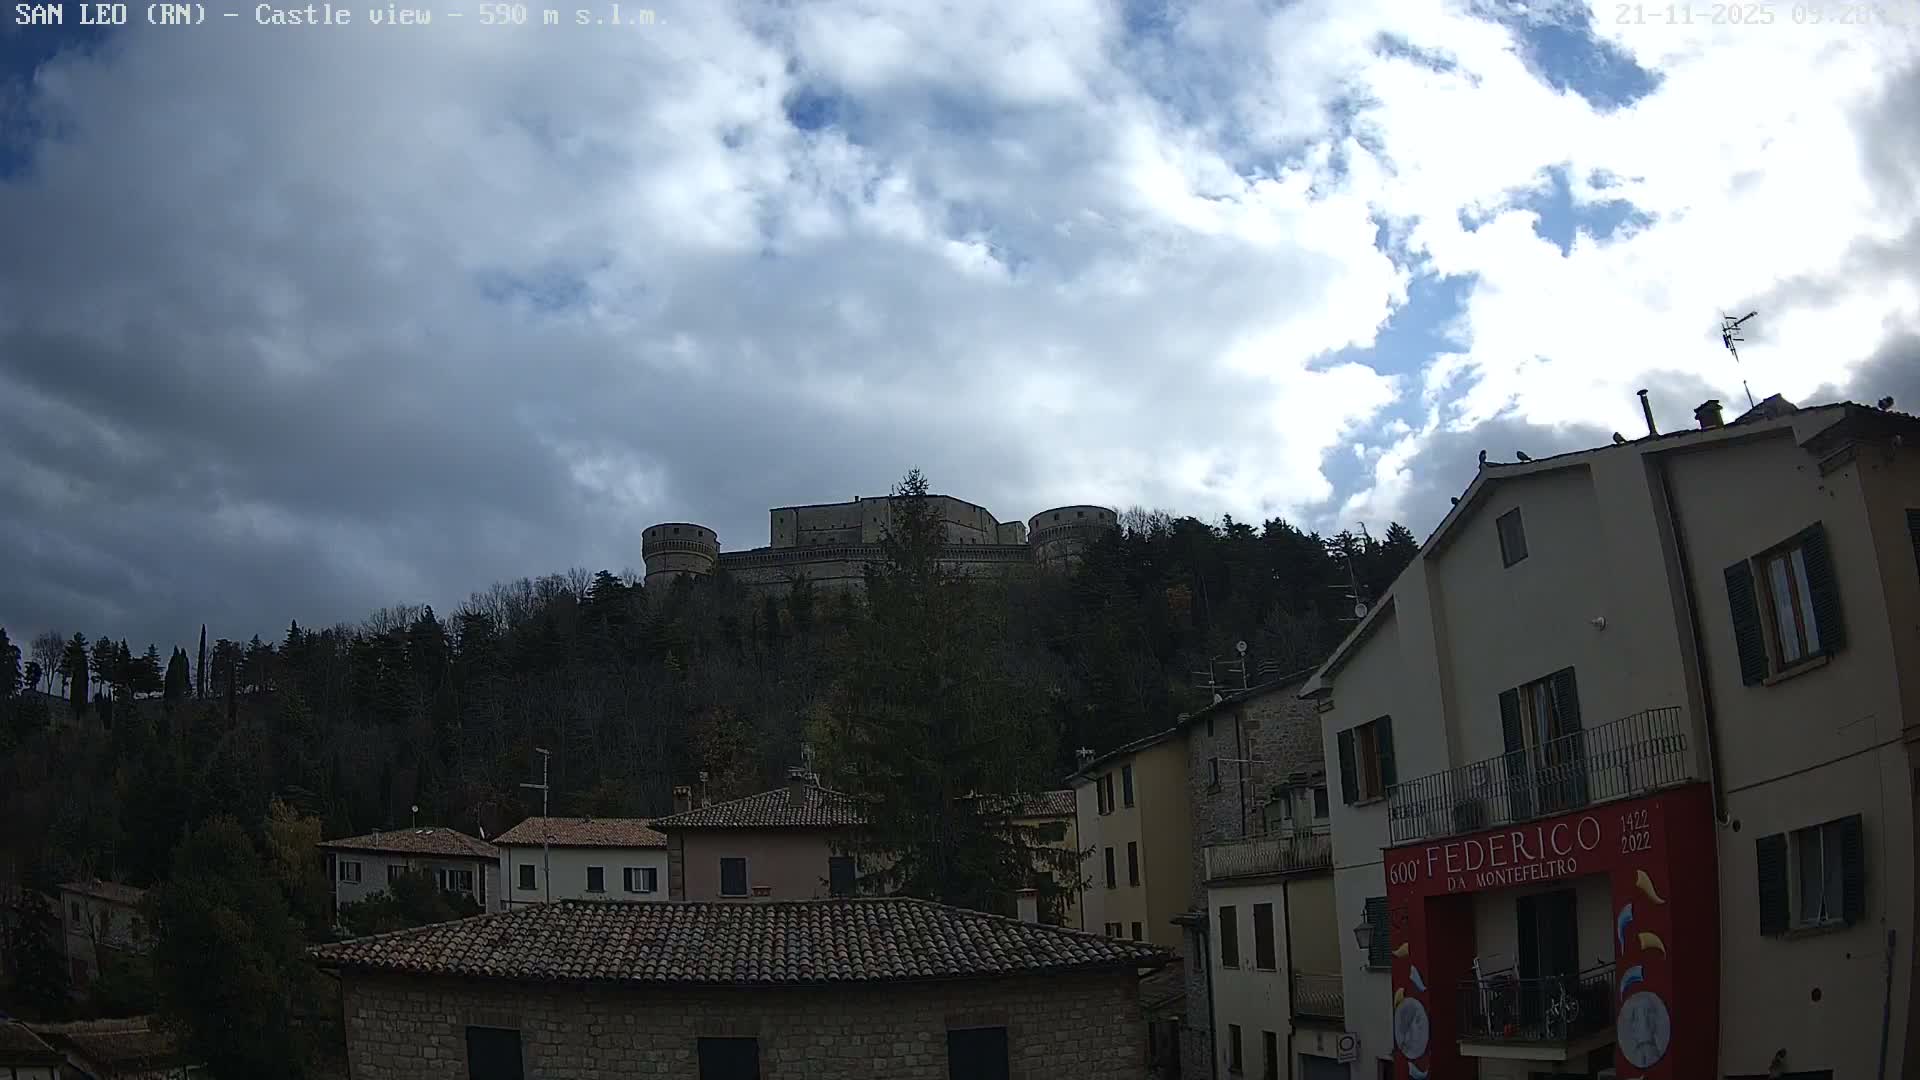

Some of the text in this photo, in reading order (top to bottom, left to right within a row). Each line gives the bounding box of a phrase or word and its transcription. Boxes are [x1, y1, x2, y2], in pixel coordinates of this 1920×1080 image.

[1620, 810, 1651, 833] 1422
[1425, 815, 1601, 877] FEDERICO
[1621, 831, 1653, 855] 2022
[1447, 857, 1577, 892] DA MONTEFELTRO
